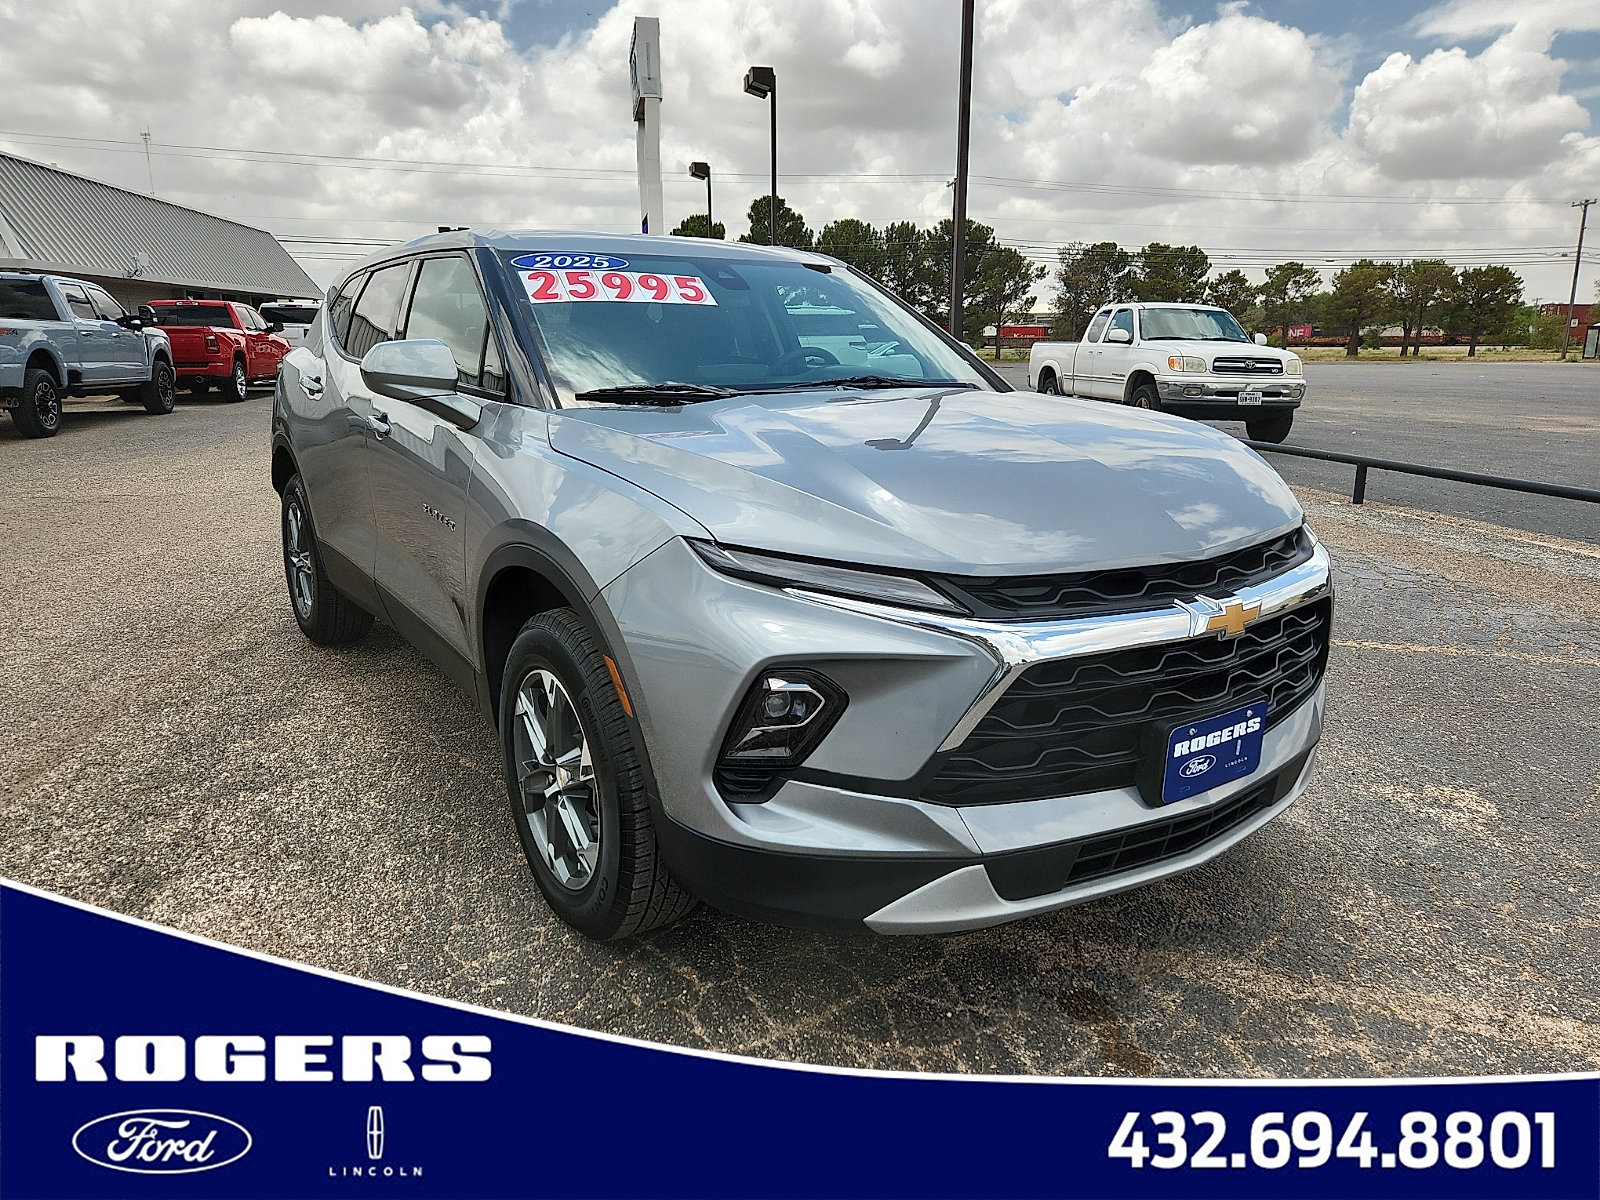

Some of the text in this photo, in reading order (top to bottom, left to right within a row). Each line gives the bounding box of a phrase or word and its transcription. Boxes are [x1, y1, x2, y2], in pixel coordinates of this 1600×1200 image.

[533, 255, 611, 269] 2025
[527, 271, 706, 302] 25995
[1173, 717, 1261, 758] ROGERS
[1185, 756, 1248, 775] Ford LINCOLN
